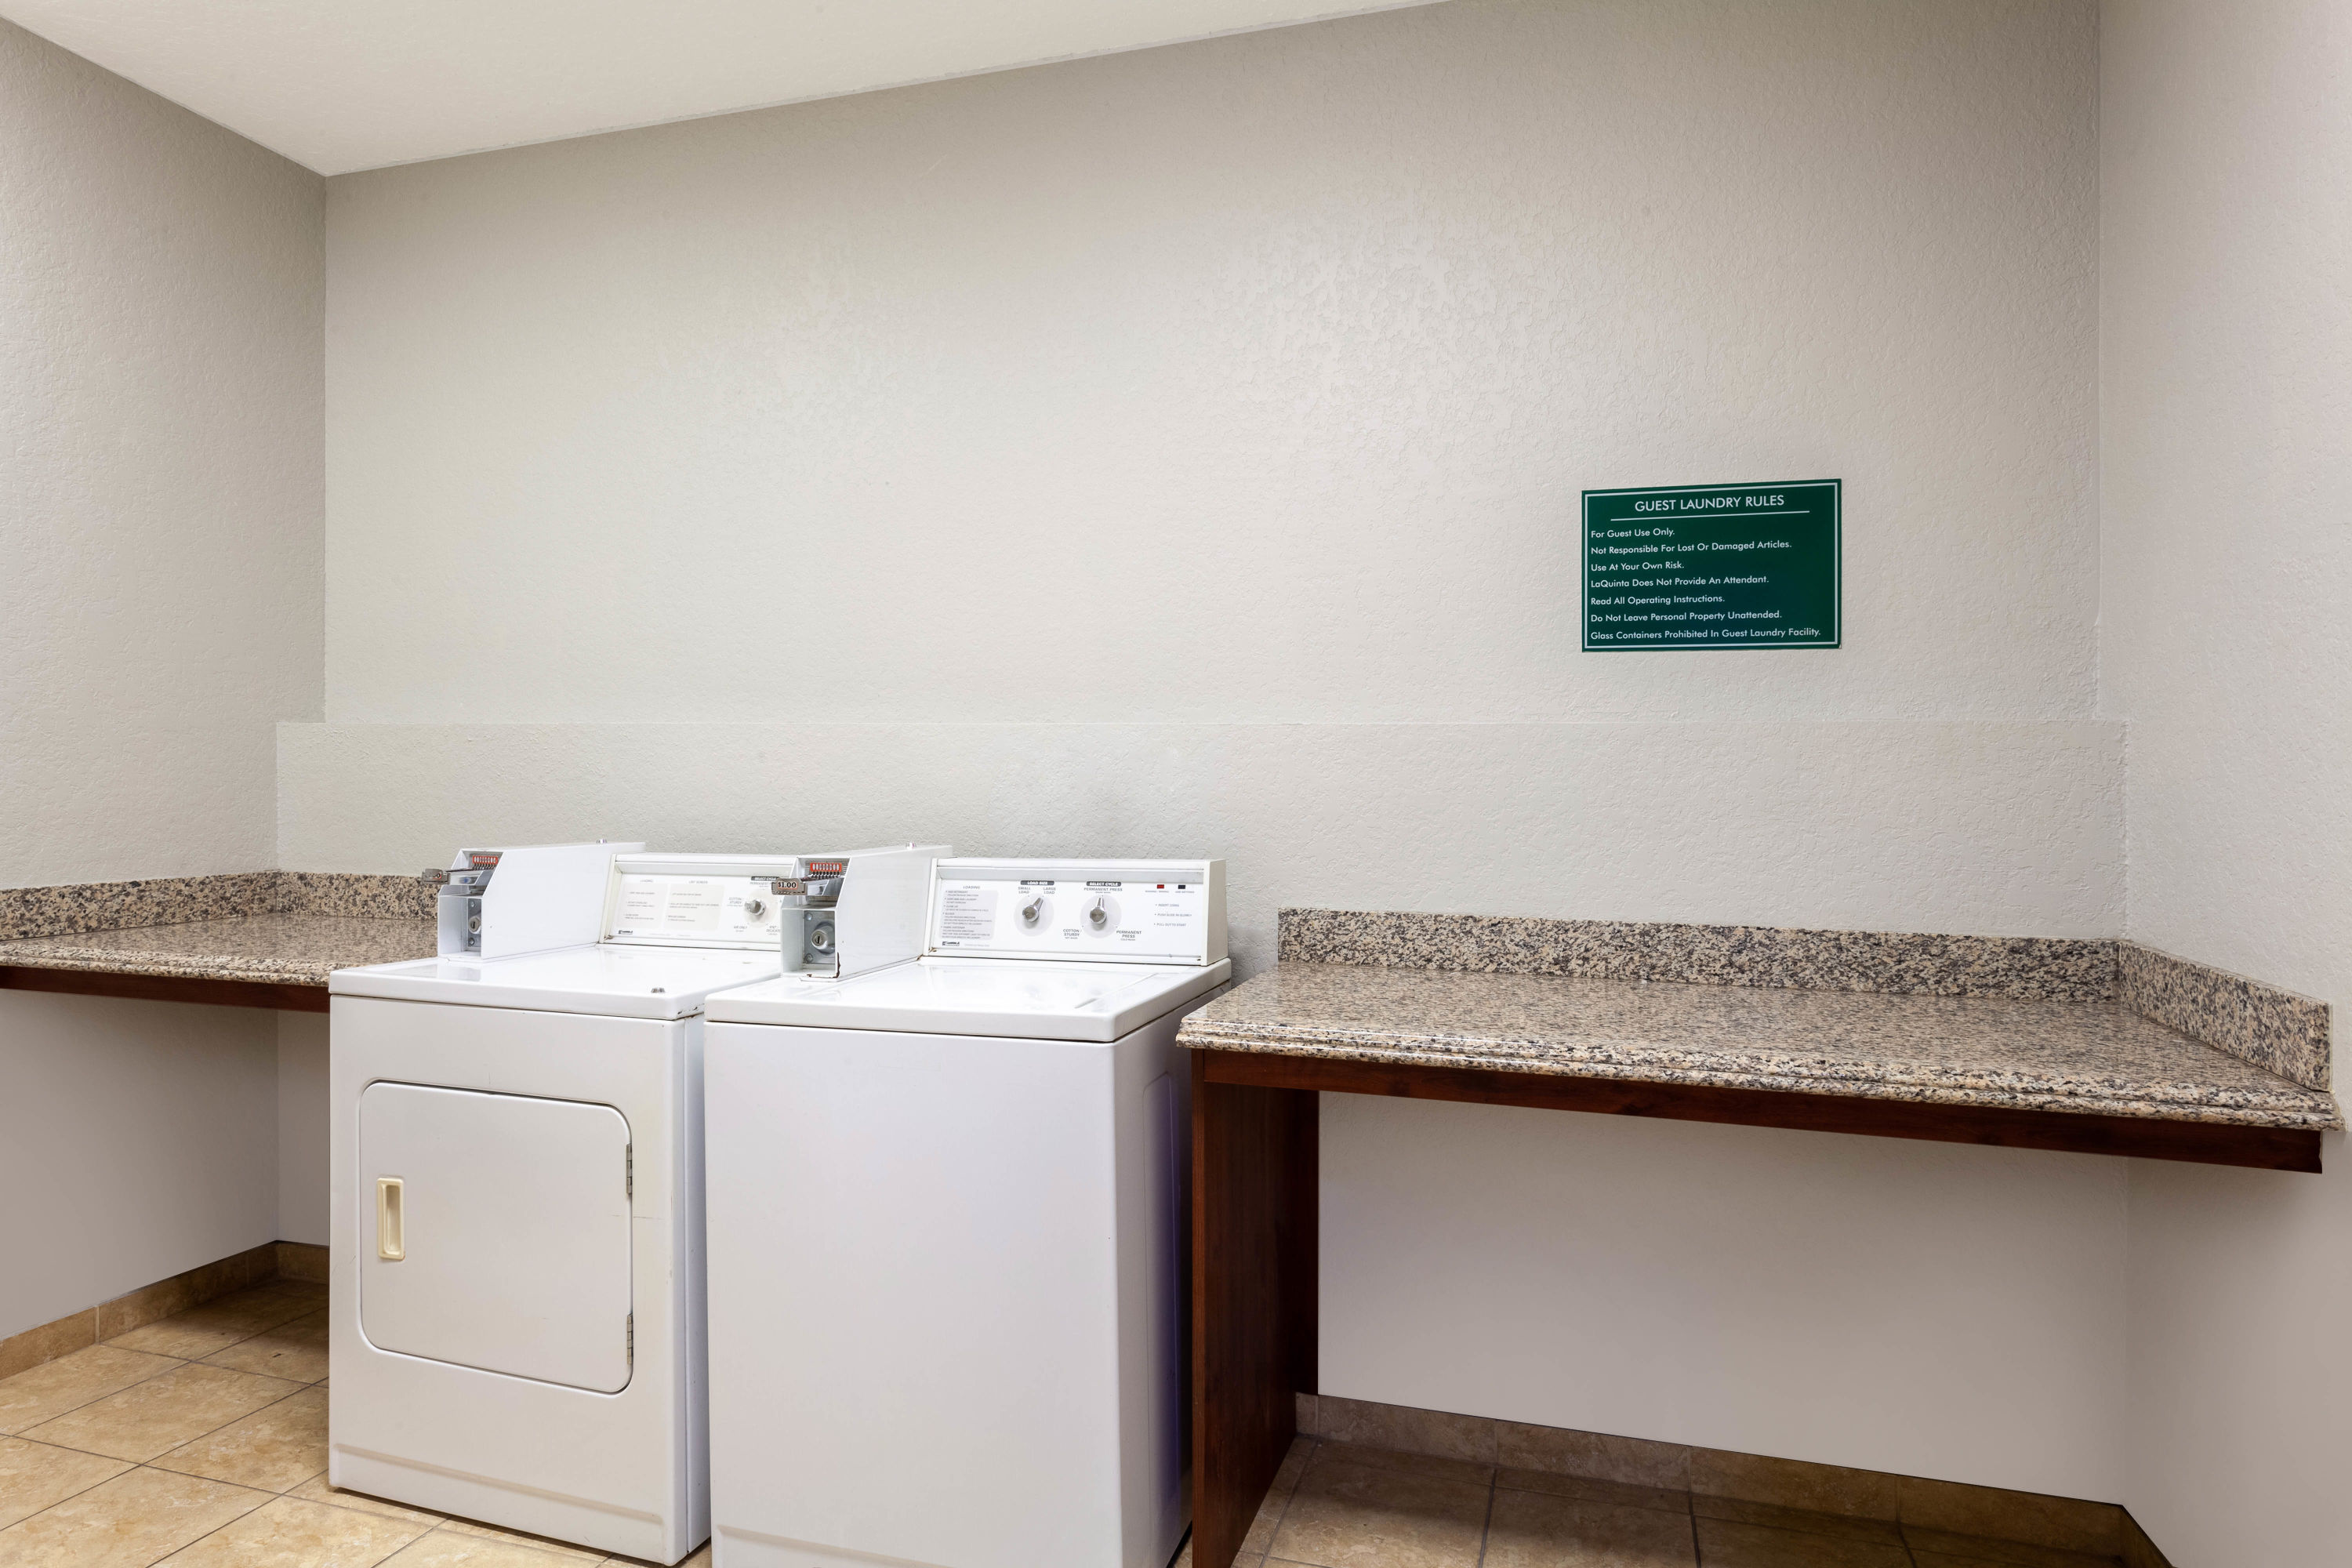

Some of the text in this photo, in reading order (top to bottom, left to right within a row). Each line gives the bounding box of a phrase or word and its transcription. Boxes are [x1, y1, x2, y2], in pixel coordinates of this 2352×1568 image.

[1635, 494, 1784, 512] GUEST LAUNDRY RULES
[1591, 527, 1675, 539] For Guest Use Only.
[1591, 546, 1607, 555] Not
[1609, 544, 1659, 556] Responsible
[1677, 543, 1695, 552] Lost
[1697, 543, 1710, 551] Or
[1711, 540, 1755, 551] Damaged
[1756, 539, 1792, 549] Articles.
[1620, 562, 1640, 571] Your
[1642, 561, 1663, 570] Own
[1665, 561, 1685, 569] Risk.
[1591, 575, 1769, 588] LaQuinta Does Not Provide An Attendant.
[1591, 594, 1725, 606] Read All Operating Instructions.
[1591, 614, 1603, 622] Do
[1624, 613, 1649, 622] Leave
[1650, 612, 1687, 621] Personal
[1690, 612, 1726, 622] Property
[1727, 610, 1782, 619] Unattended.
[1590, 631, 1613, 640] Glass
[1616, 630, 1662, 640] Containers
[1664, 629, 1708, 638] Prohibited
[1722, 629, 1748, 637] Guest
[1750, 628, 1786, 638] Laundry
[1788, 627, 1821, 637] Facility.
